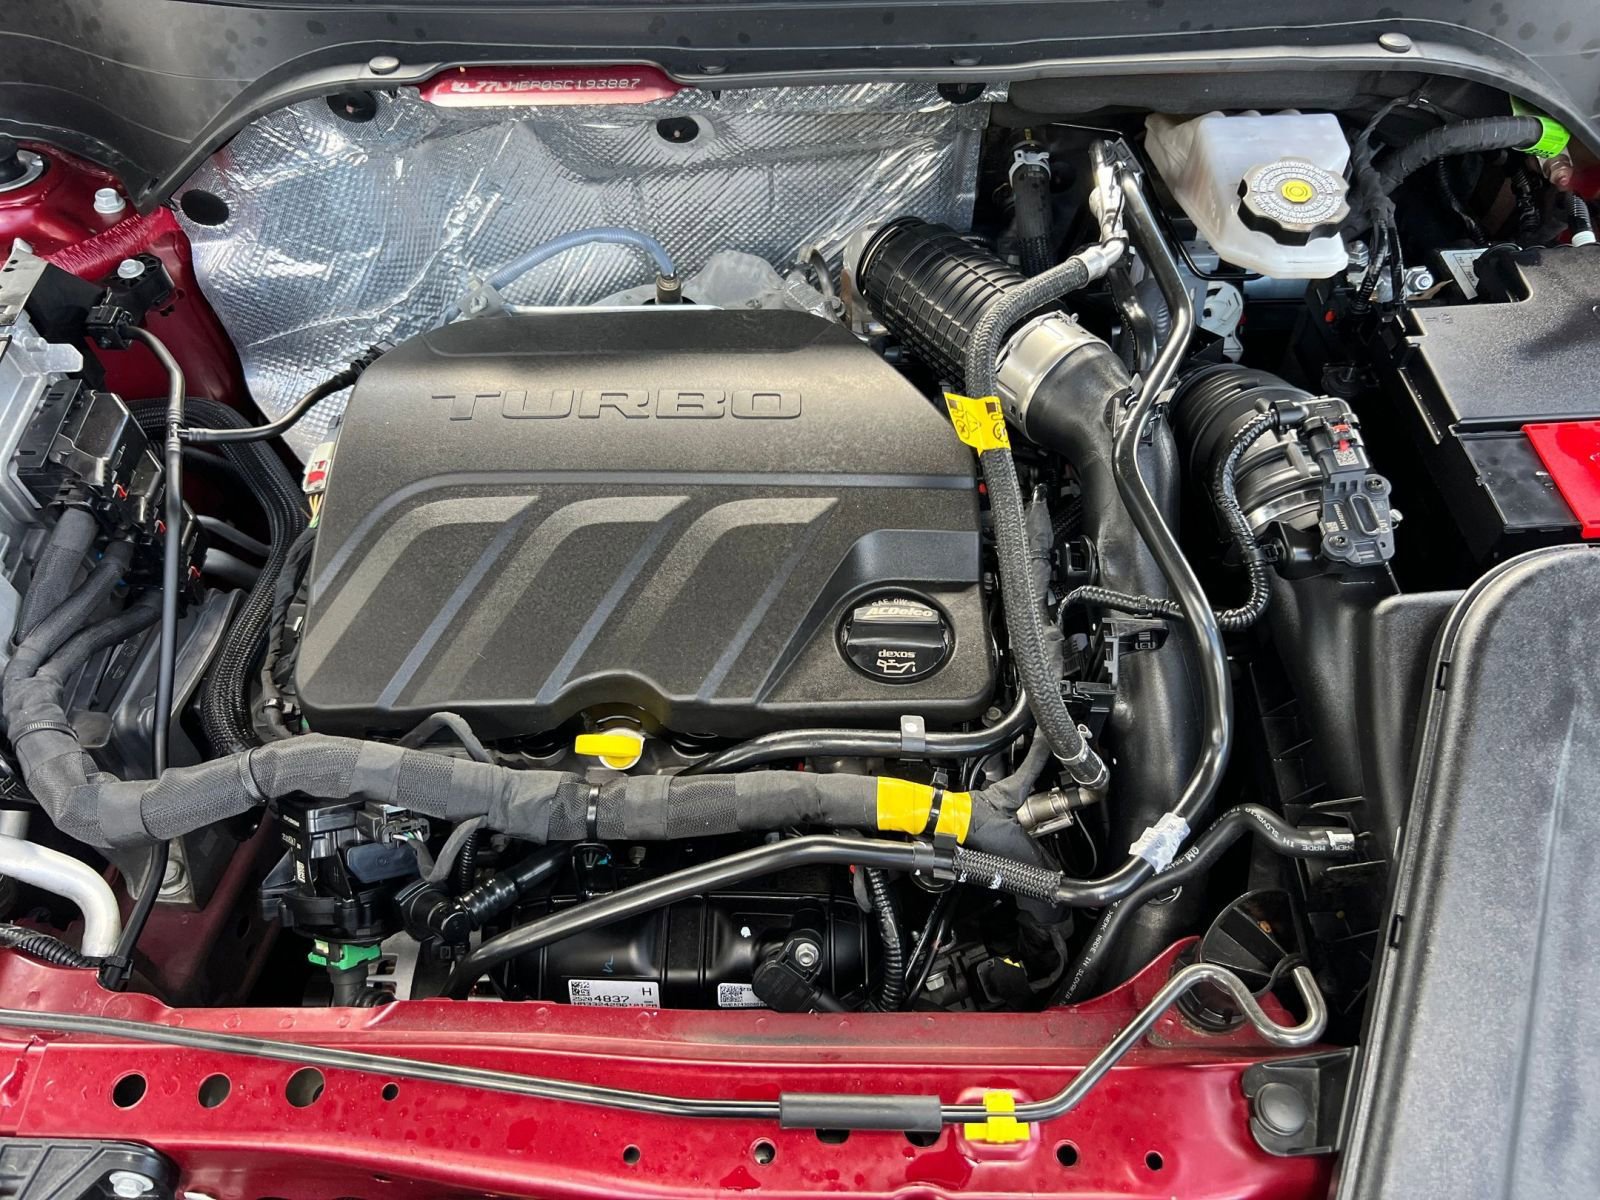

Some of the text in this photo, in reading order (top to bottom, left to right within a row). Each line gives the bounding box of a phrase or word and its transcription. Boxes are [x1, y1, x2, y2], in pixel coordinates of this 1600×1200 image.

[432, 389, 802, 421] TURBO
[864, 607, 934, 617] ACDelco
[878, 649, 916, 658] dexos
[642, 987, 652, 996] H
